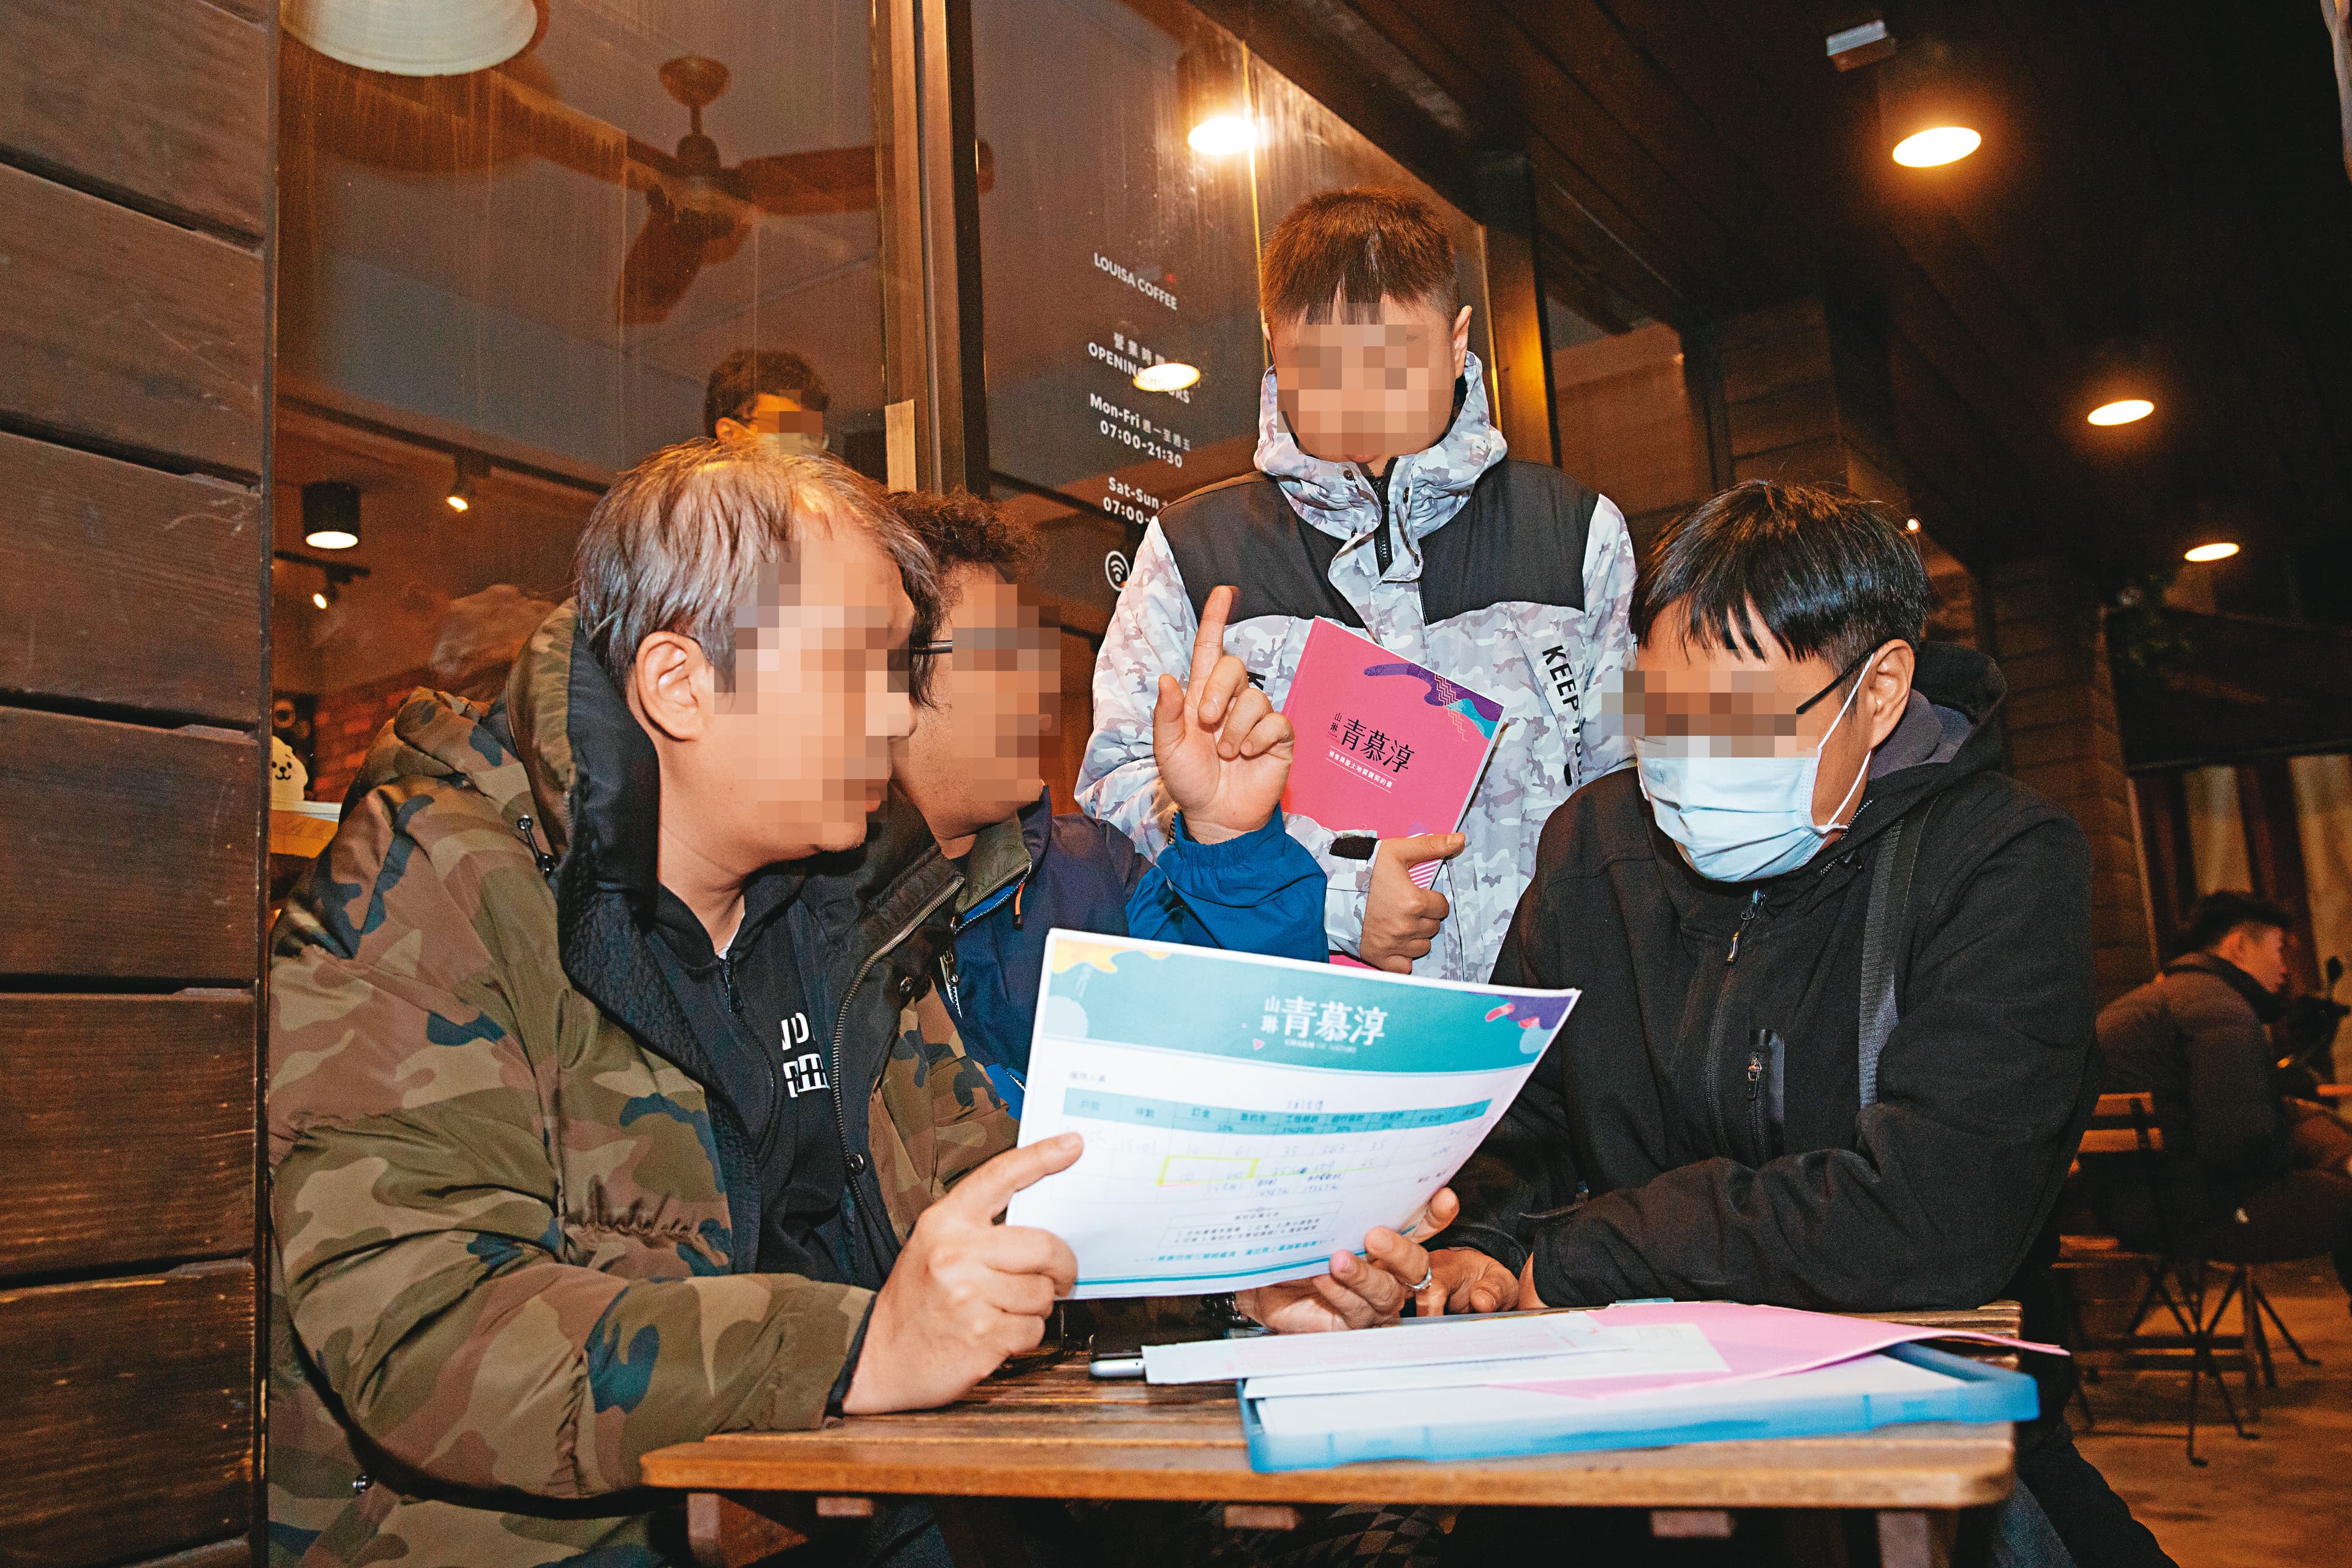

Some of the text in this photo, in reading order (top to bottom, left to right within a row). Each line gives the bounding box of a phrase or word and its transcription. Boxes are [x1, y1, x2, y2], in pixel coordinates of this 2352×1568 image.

[1093, 252, 1177, 311] LOUISA COFFEE
[1090, 393, 1140, 428] Mon-Fri
[1100, 420, 1183, 468] 07:00-21:30
[1109, 477, 1159, 510] Sat-Sun
[1542, 644, 1580, 712] KEEP
[1341, 718, 1414, 772] 青慕淳
[1281, 995, 1389, 1046] 青慕淳
